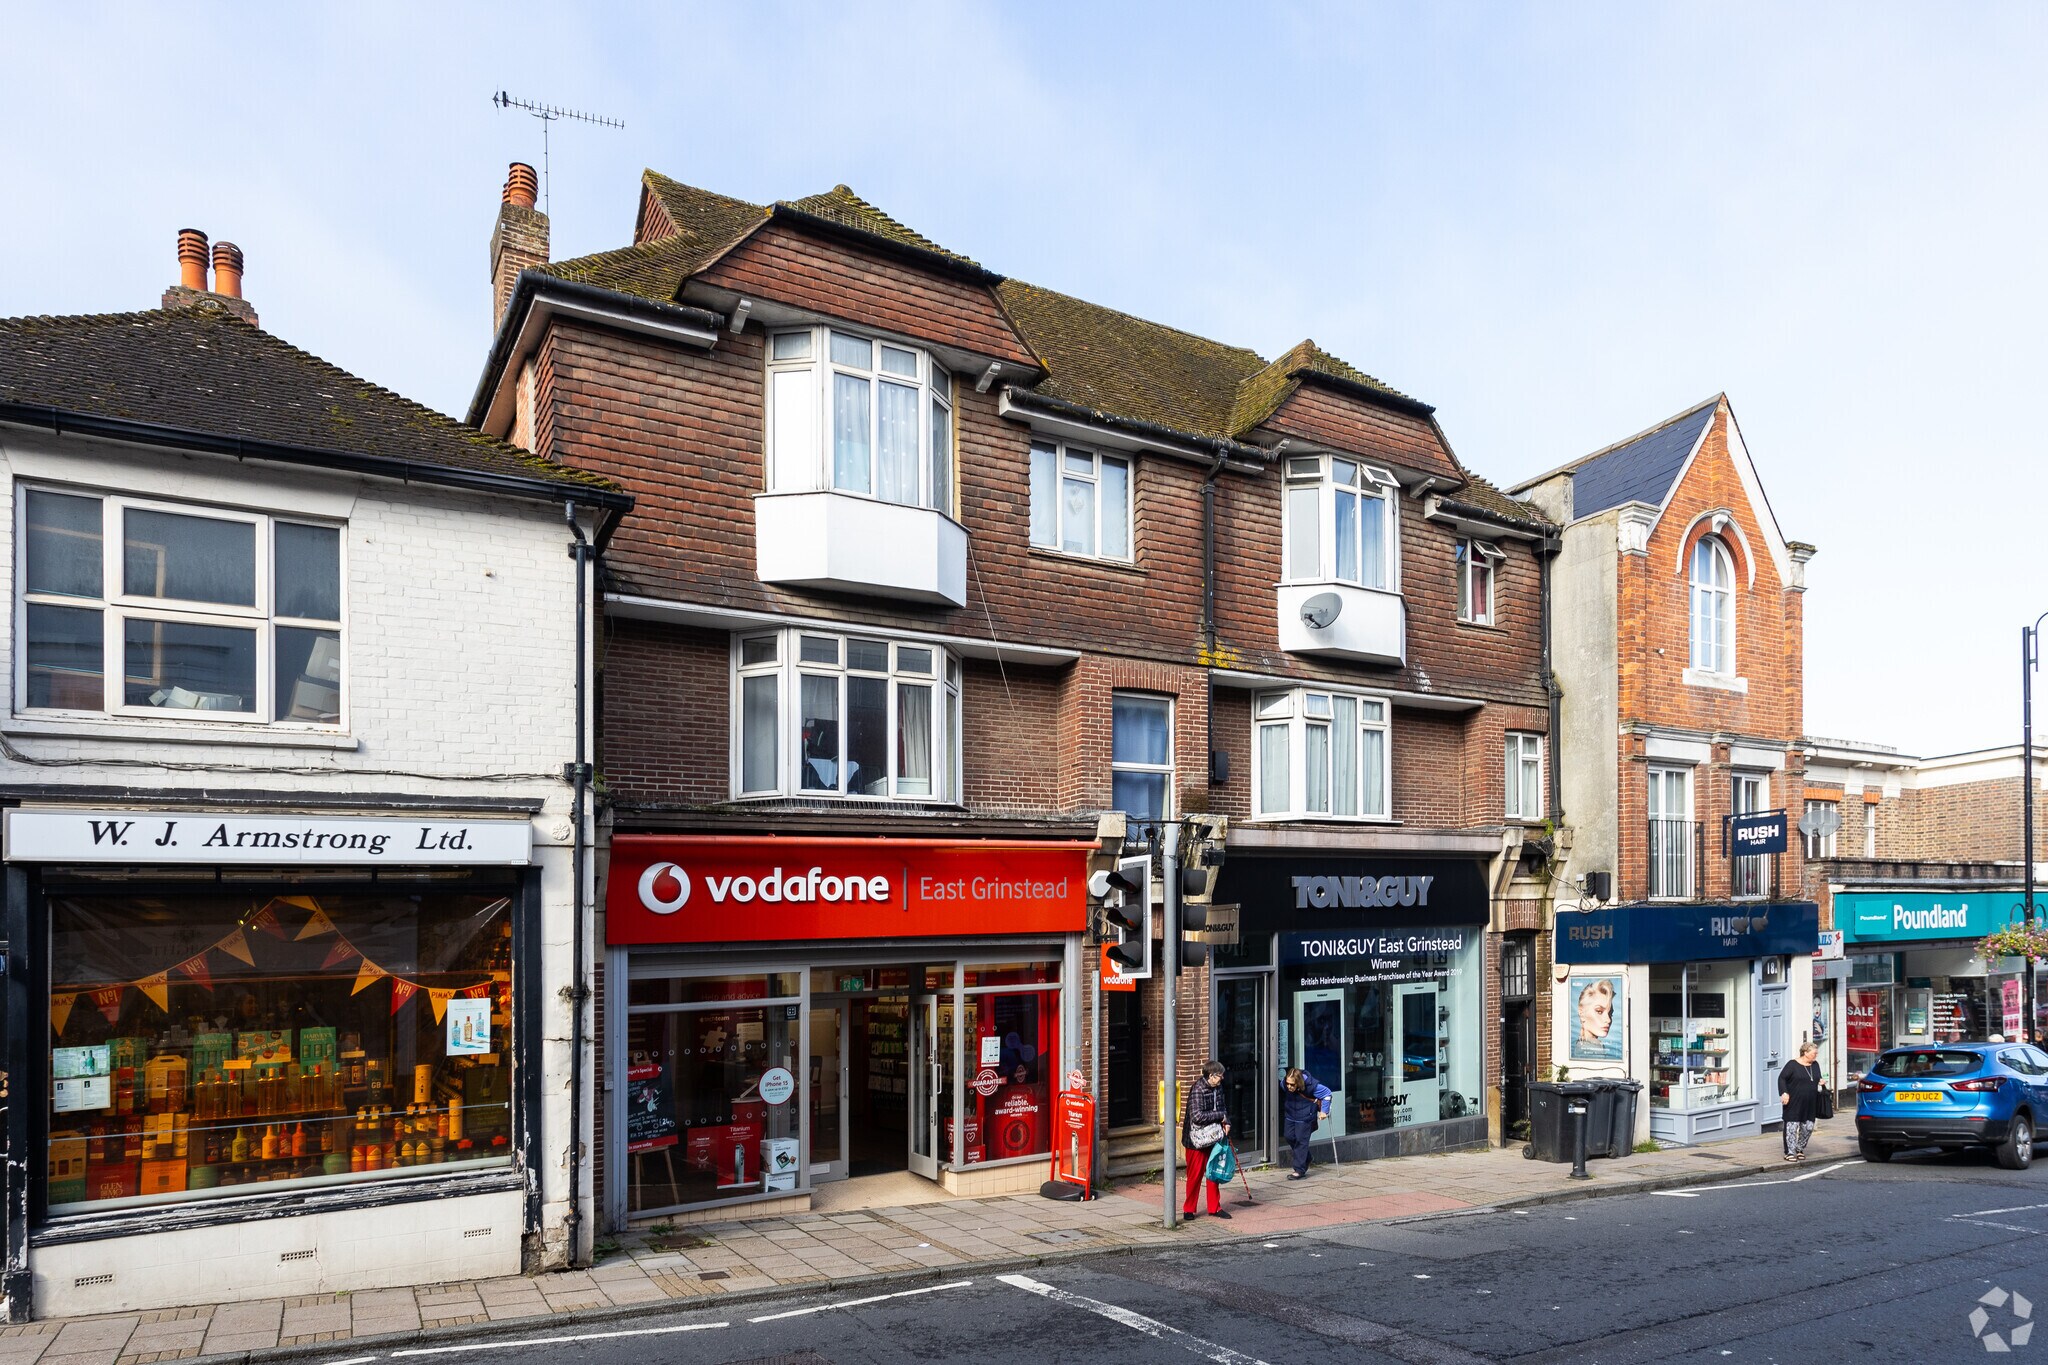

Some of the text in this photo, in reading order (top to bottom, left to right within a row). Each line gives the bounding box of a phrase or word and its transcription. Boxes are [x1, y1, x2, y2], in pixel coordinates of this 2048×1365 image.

[88, 820, 473, 855] W. J. Armstrong Ltd.
[1737, 824, 1779, 841] RUSH
[1750, 838, 1766, 846] HAIR
[705, 866, 1067, 903] vodafone East Grinstead
[1291, 875, 1434, 908] TONI&GUY
[1894, 904, 1967, 930] Poundland
[1569, 924, 1613, 941] RUSH
[1301, 934, 1462, 957] TONI&GUY East Grinstead
[1582, 940, 1600, 949] HAIR
[1723, 938, 1738, 947] HAIR
[1818, 934, 1832, 945] ILS
[1371, 958, 1400, 969] Winner
[1301, 977, 1319, 986] British
[1320, 975, 1353, 985] Hairdressing
[1355, 975, 1377, 983] Business
[1378, 972, 1405, 982] Franchisee
[1406, 971, 1411, 979] of
[1412, 971, 1420, 979] the
[1421, 970, 1433, 978] Year
[1433, 969, 1449, 977] Award
[52, 996, 75, 1008] IMM'S
[1847, 1006, 1874, 1016] SALE
[1922, 1092, 1939, 1100] UCZ
[995, 1104, 1039, 1115] award-winning
